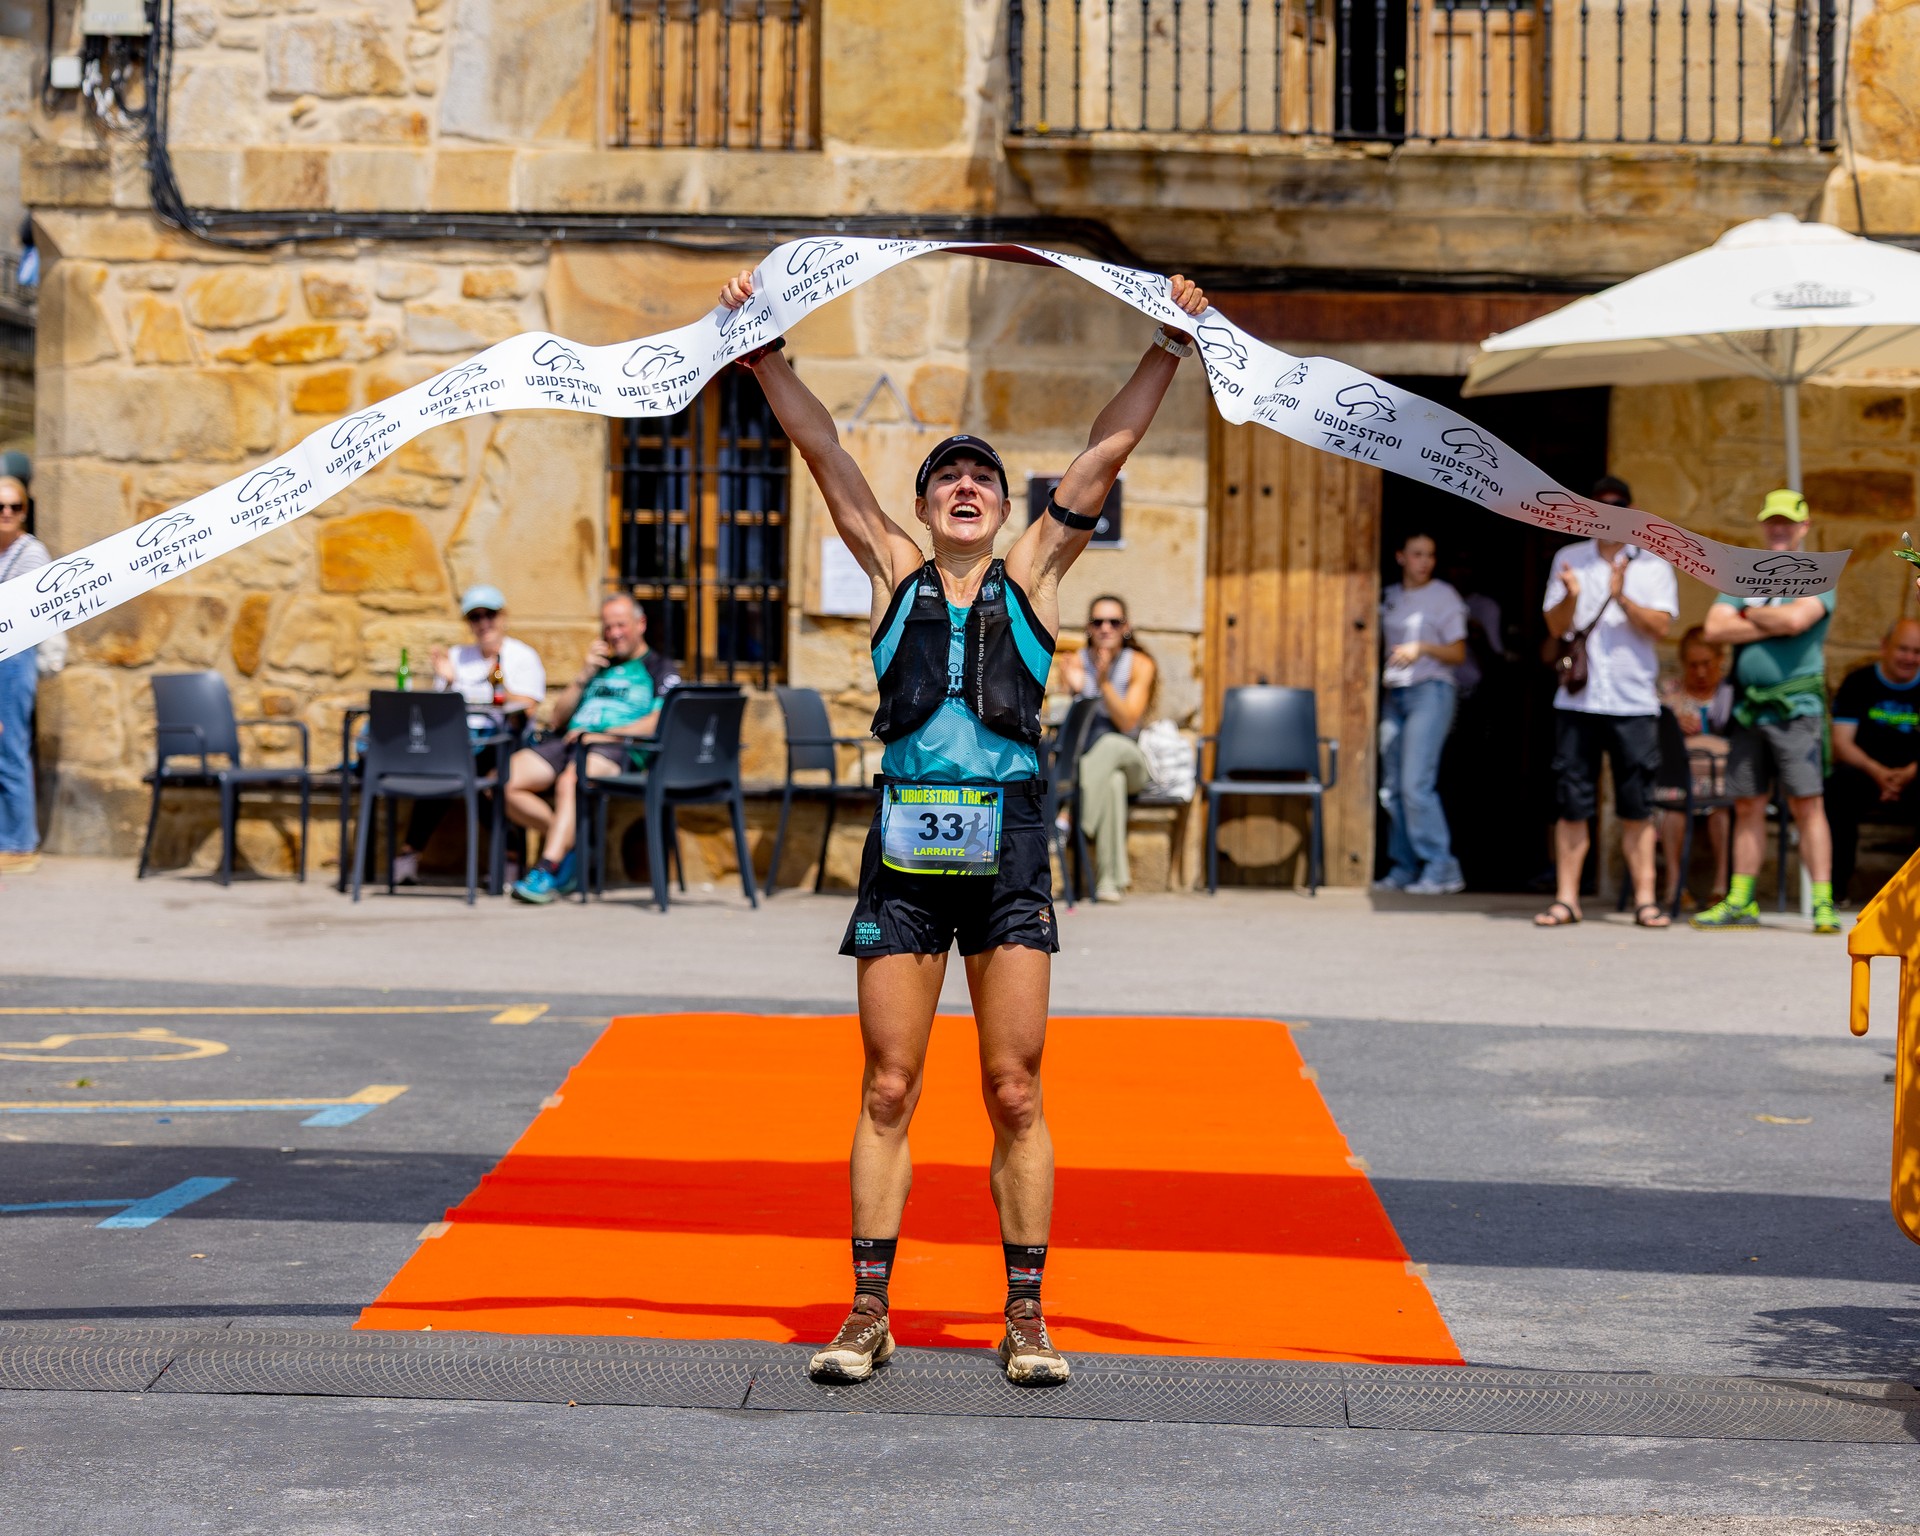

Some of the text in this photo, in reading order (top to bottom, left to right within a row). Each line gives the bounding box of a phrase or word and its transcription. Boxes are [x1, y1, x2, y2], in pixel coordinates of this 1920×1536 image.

[782, 252, 860, 302] UBIDESTROI
[797, 273, 854, 309] TRAIL
[1101, 265, 1176, 317] UBIDESTROI
[1111, 279, 1163, 319] TRAIL
[719, 330, 768, 362] TRAIL
[525, 375, 601, 395] UBIDESTROI
[617, 366, 700, 397] UBIDESTROI
[1204, 358, 1244, 397] STROI
[419, 379, 505, 416] UBIDESTROI
[434, 396, 496, 420] TRAIL
[541, 390, 598, 408] TRAIL
[633, 389, 693, 413] TRAIL
[1253, 405, 1278, 423] AIL
[1314, 408, 1402, 449] UBIDESTROI
[326, 420, 401, 474] UBIDESTROI
[340, 440, 394, 478] TRAIL
[1320, 431, 1382, 462] TRAIL
[1420, 447, 1504, 497] UBIDESTROI
[1428, 467, 1488, 502] TRAIL
[231, 479, 313, 525] UBIDESTROI
[245, 501, 307, 533] TRAIL
[1520, 501, 1610, 531] UBIDESTROI
[1531, 516, 1595, 536] TRAIL
[129, 526, 213, 571] UBIDESTROI
[144, 547, 207, 580] TRAIL
[1631, 529, 1716, 576] UBIDESTROI
[1648, 543, 1701, 578] TRAIL
[30, 572, 112, 618] UBIDESTROI
[1735, 576, 1828, 586] UBIDESTROI
[1749, 587, 1811, 596] TRAIL
[46, 594, 107, 628] TRAIL
[901, 789, 959, 804] UBIDESTROI
[918, 812, 964, 841] 33
[913, 847, 965, 857] LARRAITZ
